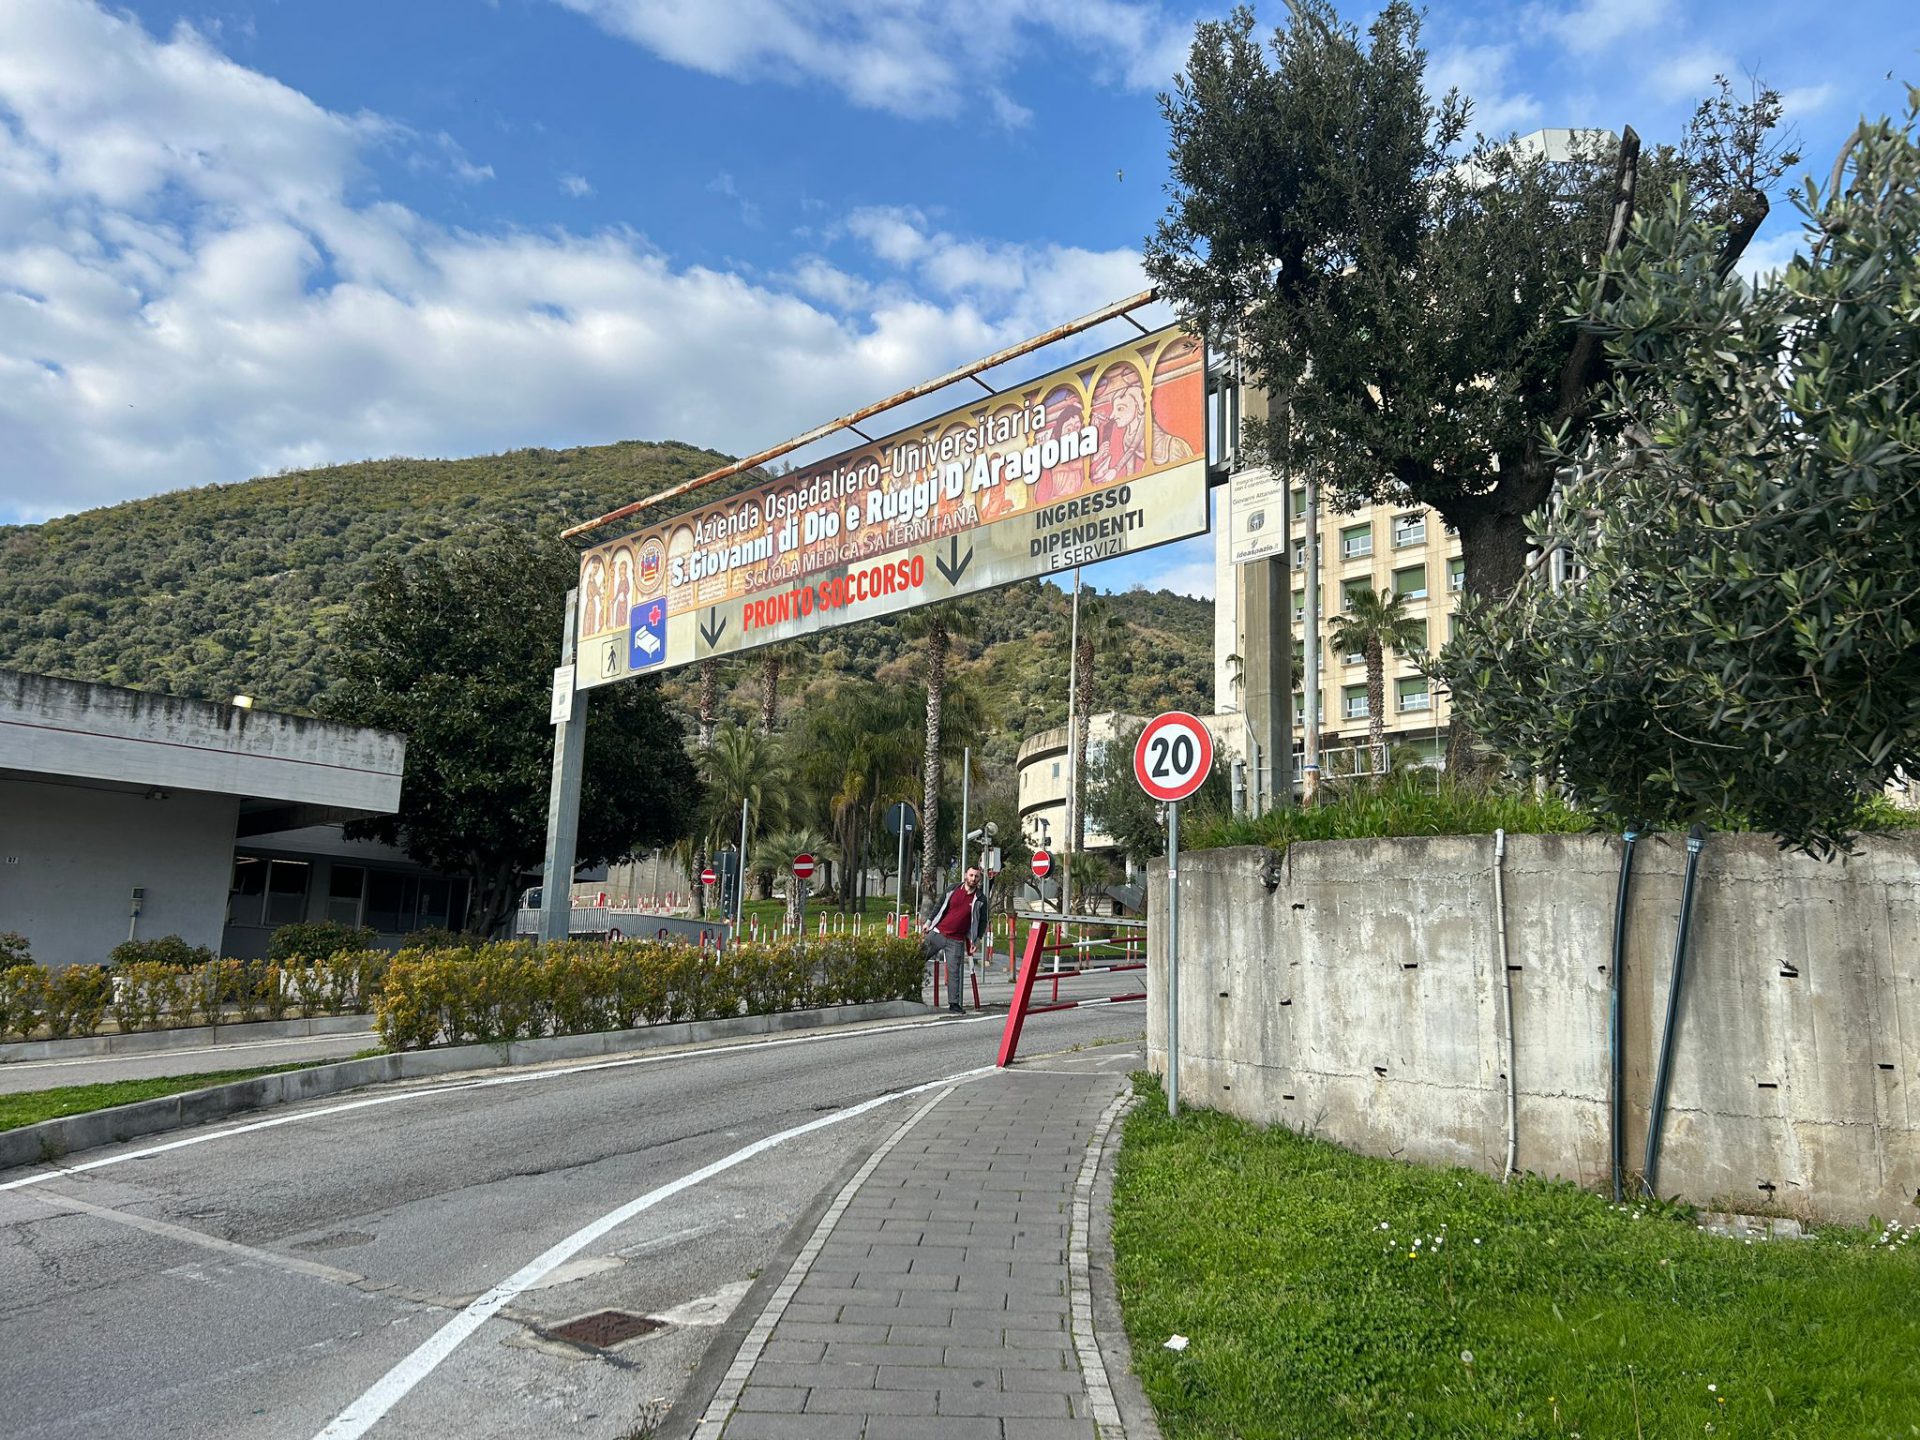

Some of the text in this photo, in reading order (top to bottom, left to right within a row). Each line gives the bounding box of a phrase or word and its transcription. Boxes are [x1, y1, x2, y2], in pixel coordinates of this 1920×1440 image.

[694, 398, 1046, 547] Azienda Ospedaliero-Universitaria
[672, 526, 773, 588] S.Giovanni
[778, 516, 799, 553] di
[804, 507, 840, 546] Dio
[845, 505, 860, 531] e
[866, 469, 939, 525] Ruggi
[945, 425, 1098, 501] D'Aragona
[1030, 509, 1144, 557] DIPENDENTI
[1036, 486, 1131, 529] INGRESSO
[744, 558, 801, 590] SCUOLA
[802, 541, 860, 573] MEDICA
[863, 504, 979, 553] SALERNITANA
[1051, 537, 1122, 569] E SERVIZI
[743, 585, 814, 632] PRONTO
[818, 554, 925, 612] SOCCORSO
[1151, 734, 1194, 778] 20
